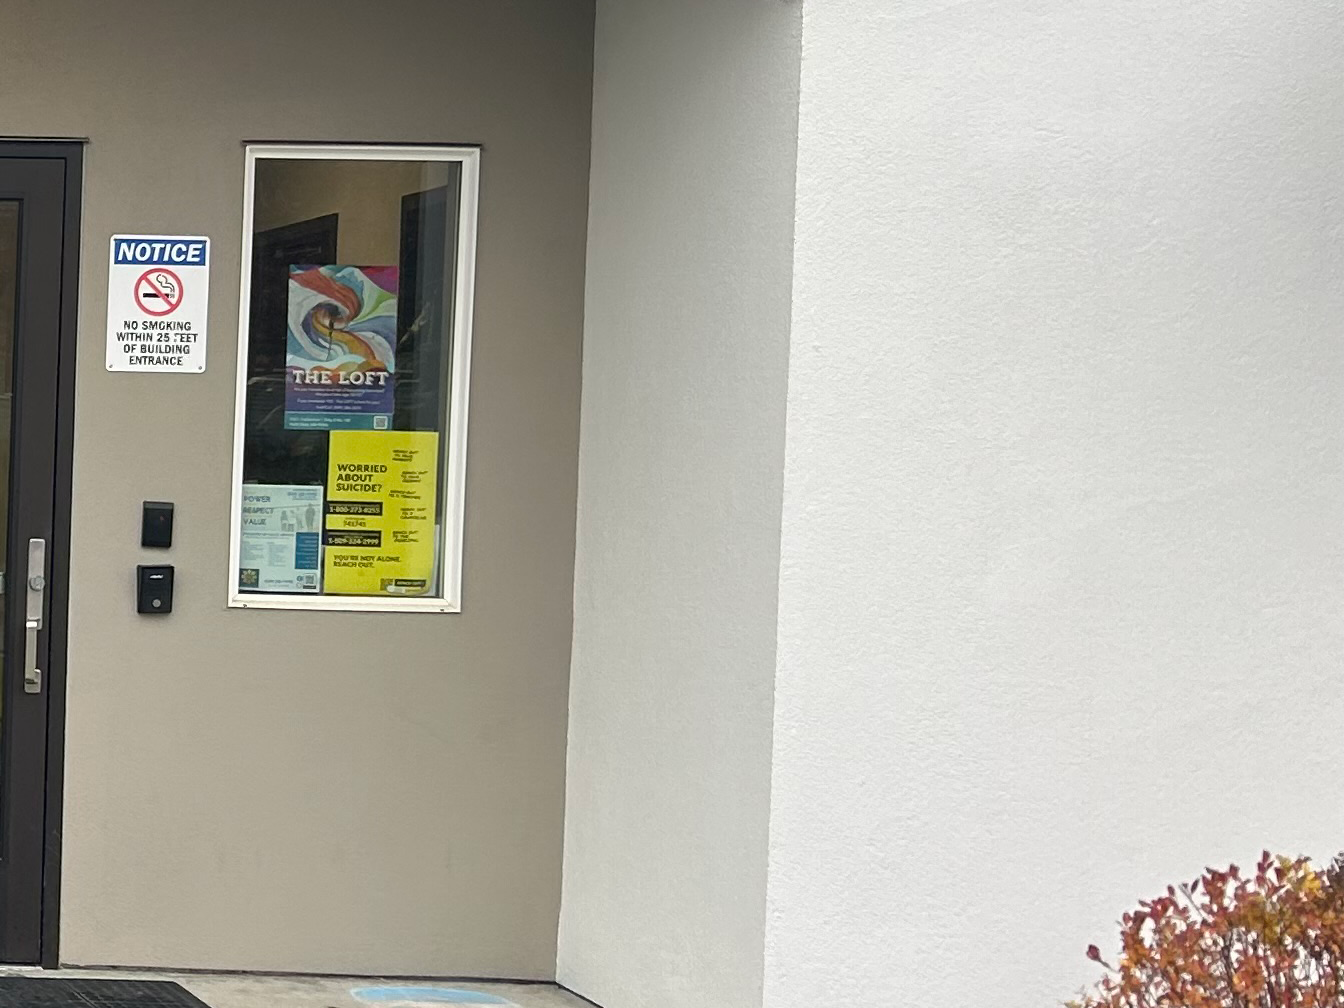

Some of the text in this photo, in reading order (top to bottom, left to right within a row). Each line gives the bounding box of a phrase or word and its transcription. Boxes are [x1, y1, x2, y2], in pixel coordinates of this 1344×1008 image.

[117, 242, 203, 262] NOTICE
[123, 320, 192, 331] NO SMOKING
[116, 332, 153, 342] WITHIN
[156, 333, 170, 342] 25
[123, 344, 191, 354] OF BUILDING
[128, 356, 184, 366] ENTRANCE
[292, 369, 389, 386] THE LOFT
[336, 464, 388, 473] WORRIED
[336, 474, 374, 482] ABOUT
[335, 483, 383, 493] SUICIDE?
[243, 495, 271, 503] POWER
